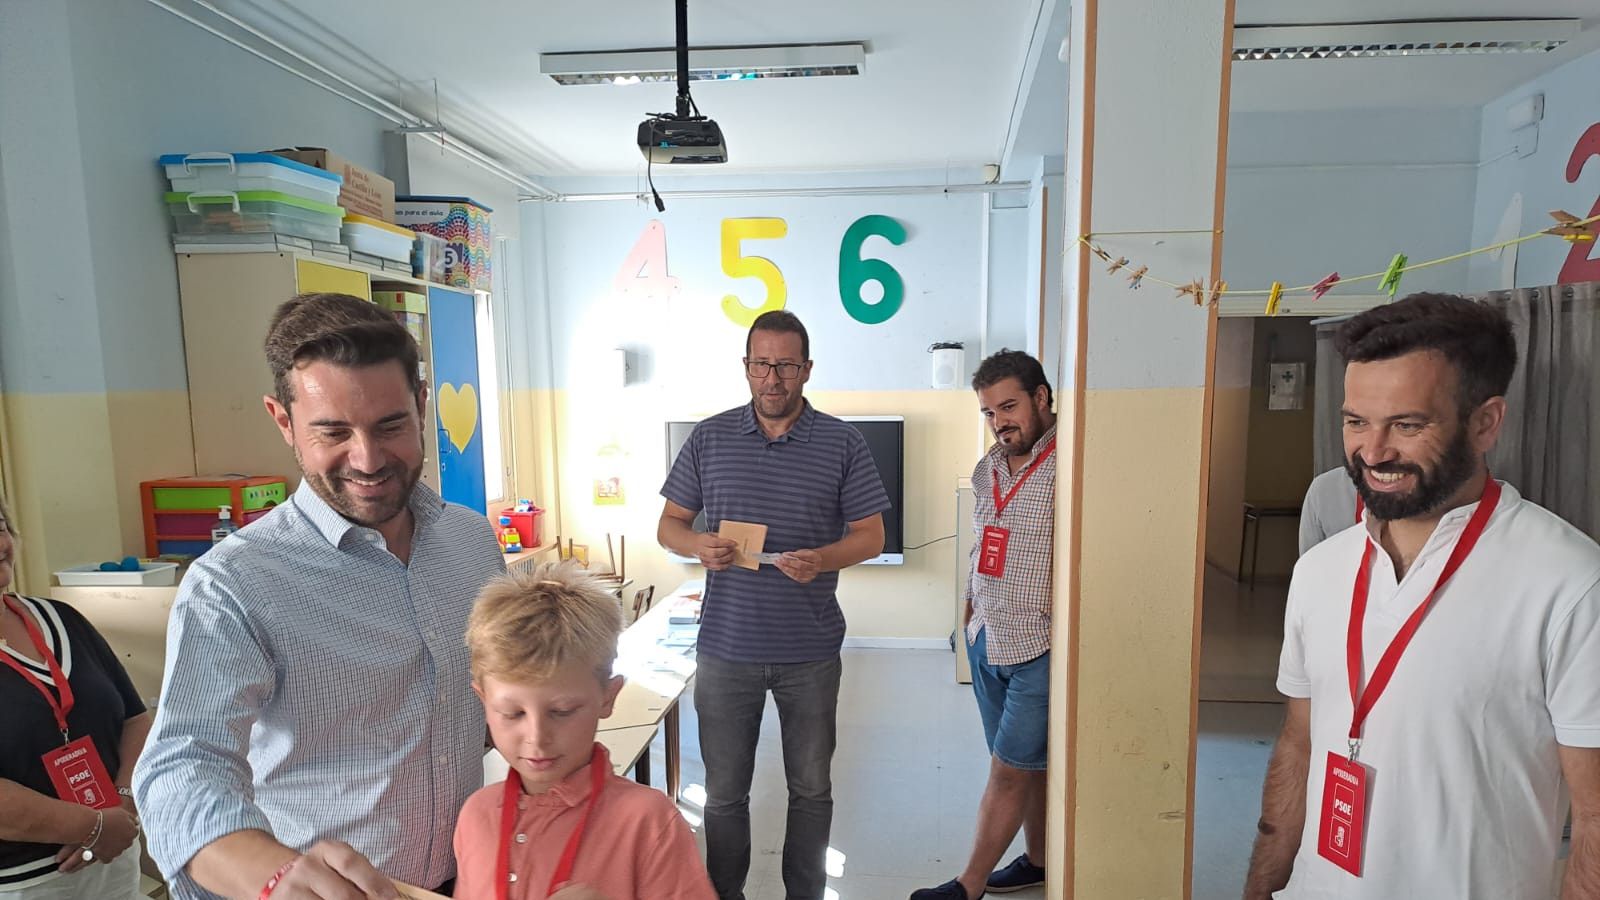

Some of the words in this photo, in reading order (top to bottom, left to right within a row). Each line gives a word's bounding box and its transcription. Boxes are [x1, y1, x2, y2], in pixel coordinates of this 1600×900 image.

[444, 250, 454, 266] 5
[613, 219, 682, 302] 4
[720, 216, 788, 328] 5
[838, 214, 907, 325] 6
[69, 769, 91, 785] PSOE
[1334, 798, 1352, 816] PSOE
